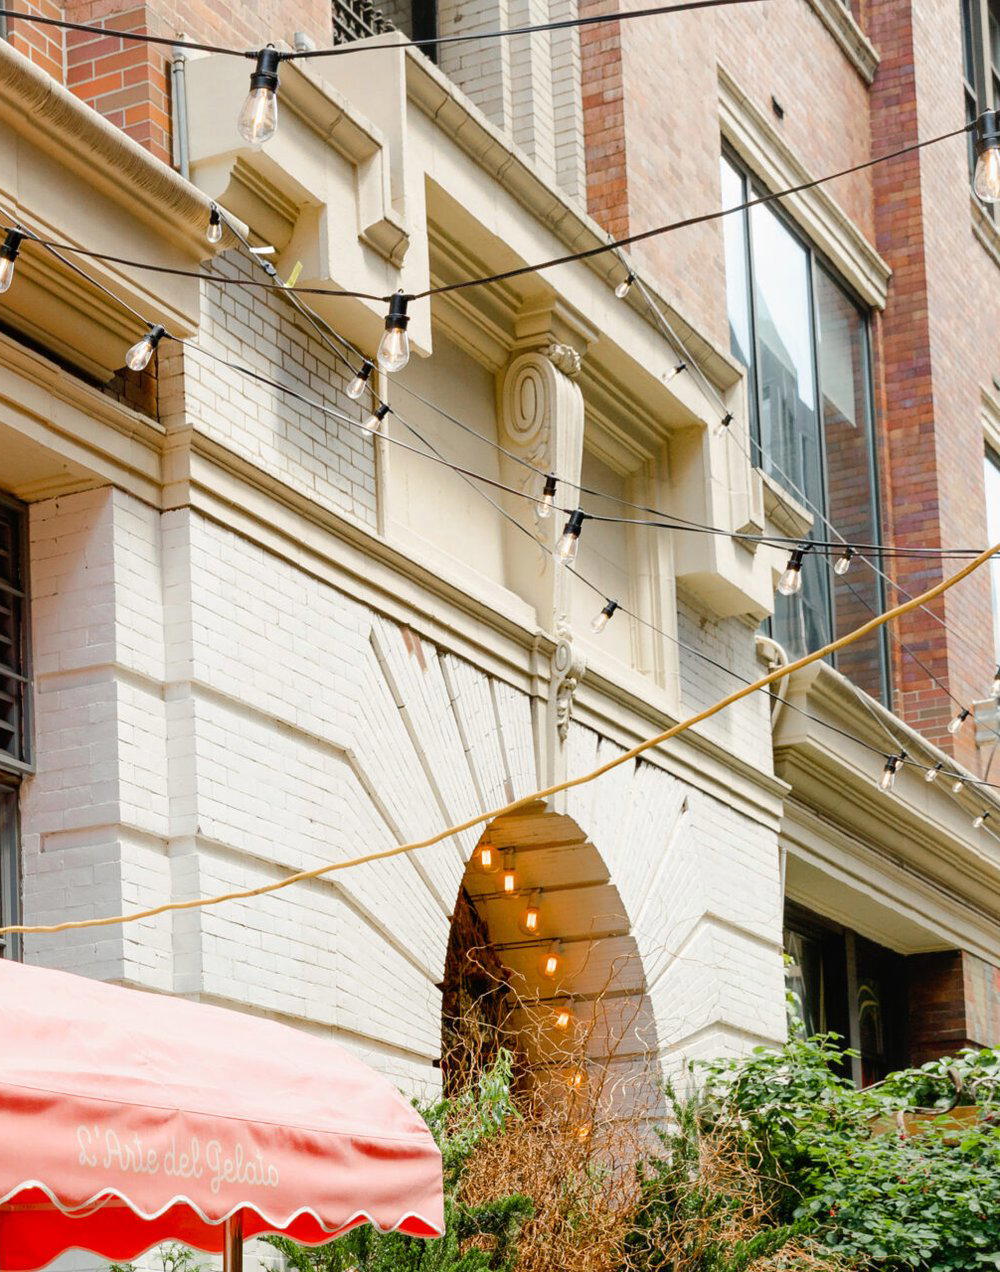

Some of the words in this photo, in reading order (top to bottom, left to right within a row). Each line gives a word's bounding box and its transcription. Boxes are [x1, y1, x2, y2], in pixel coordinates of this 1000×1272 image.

[76, 1125, 160, 1175] L'Arte
[164, 1140, 203, 1179] del
[206, 1140, 281, 1194] Gelato
